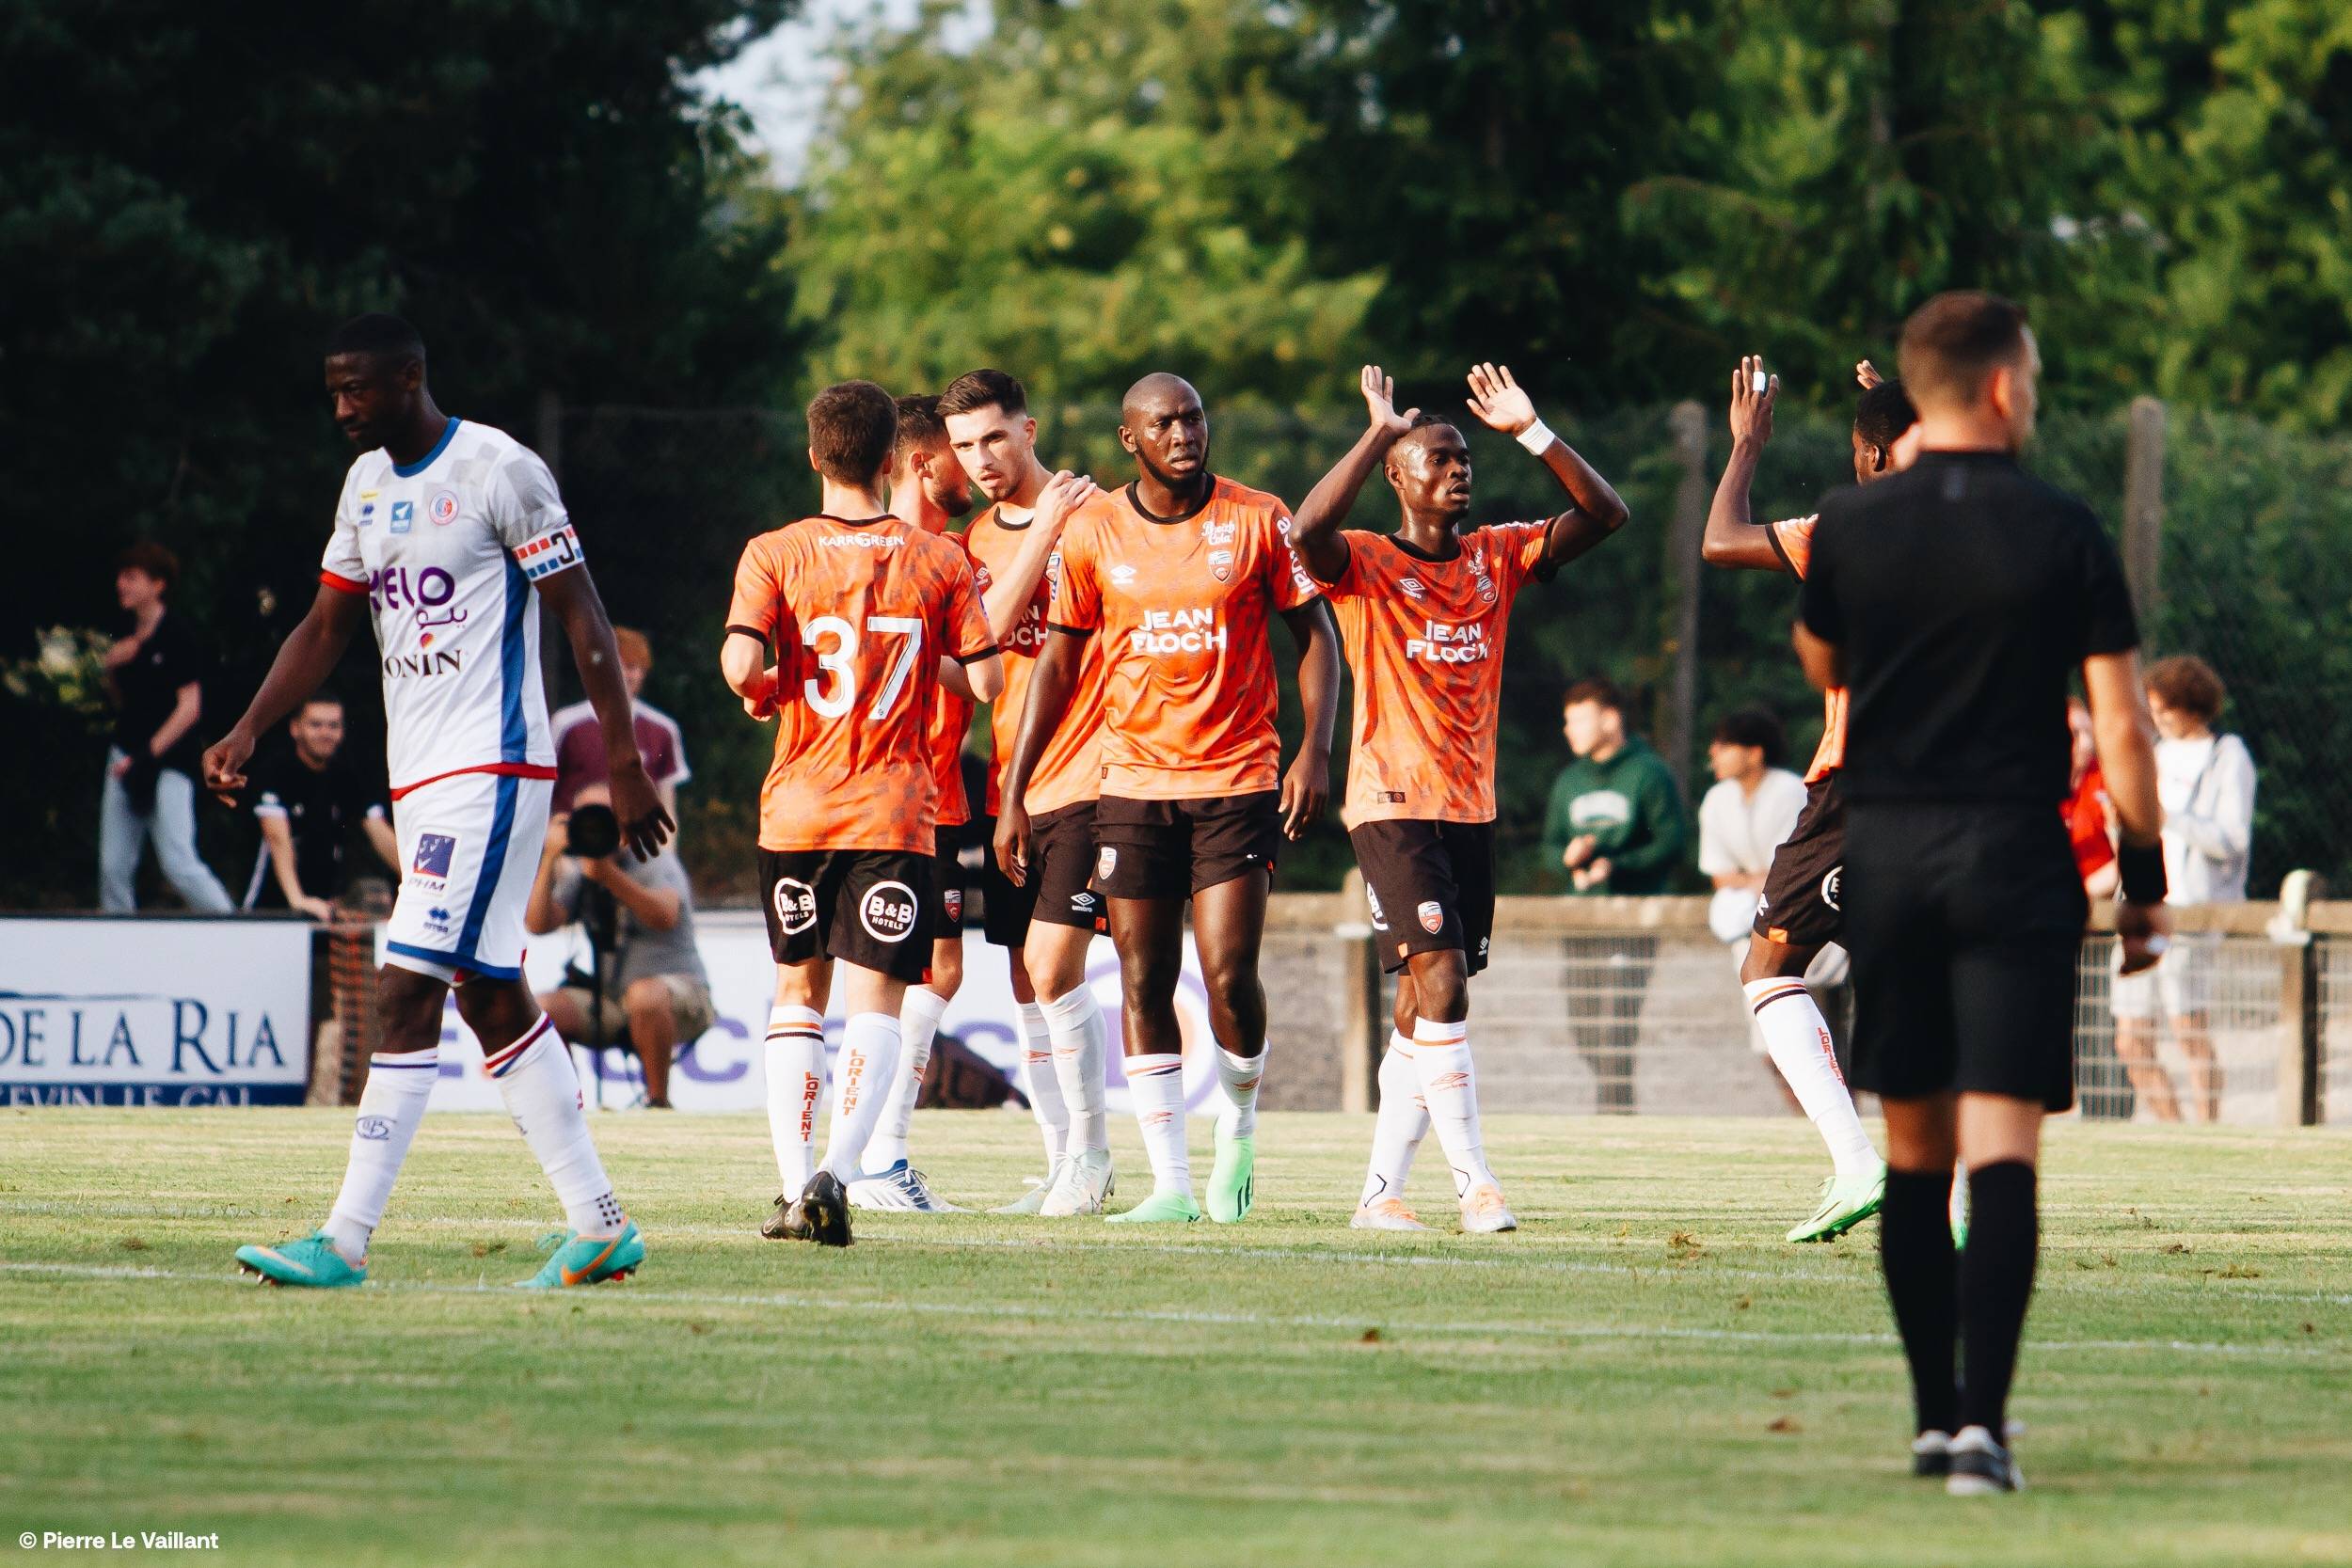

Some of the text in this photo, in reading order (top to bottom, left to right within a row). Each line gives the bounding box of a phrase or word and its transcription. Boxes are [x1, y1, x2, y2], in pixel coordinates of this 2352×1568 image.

[818, 531, 905, 547] KARRGREEN
[1137, 608, 1214, 631] JEAN
[1130, 627, 1228, 653] FLOC'H
[383, 649, 461, 678] ONIN
[803, 615, 923, 720] 37
[867, 895, 913, 924] B&B
[871, 916, 904, 930] HOTELS
[69, 1009, 142, 1067] LA
[169, 997, 287, 1075] RIA
[843, 1047, 867, 1117] LORIENT
[800, 1070, 820, 1142] LORIENT
